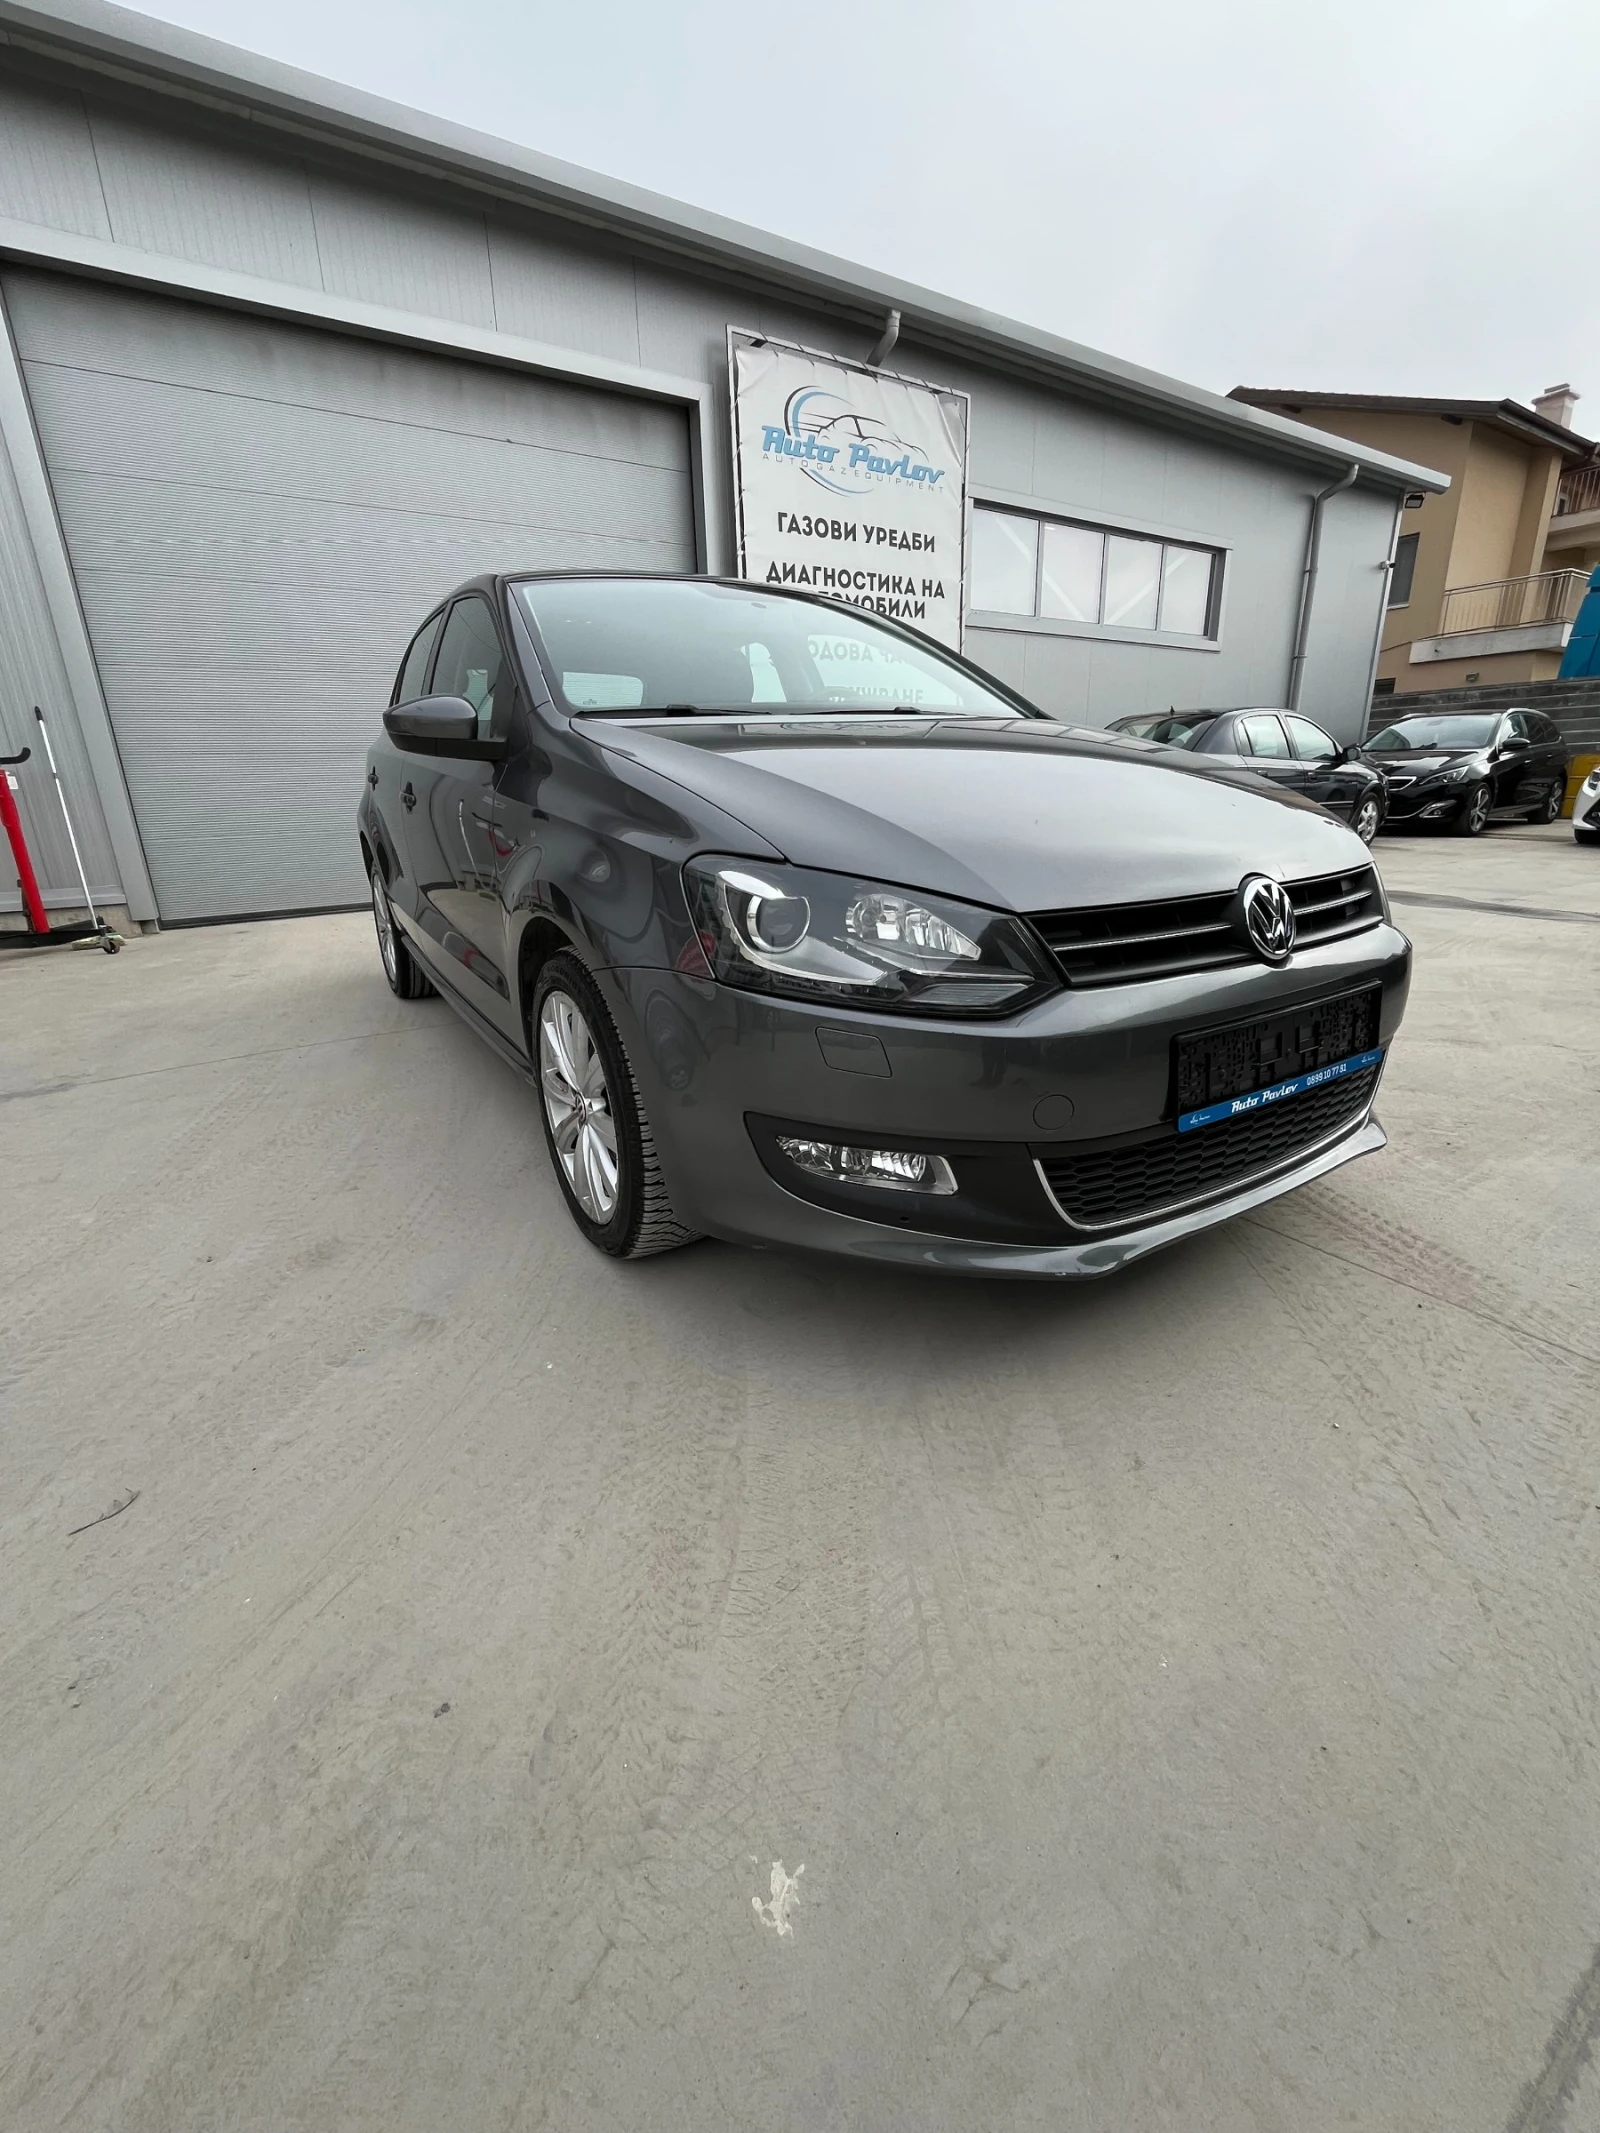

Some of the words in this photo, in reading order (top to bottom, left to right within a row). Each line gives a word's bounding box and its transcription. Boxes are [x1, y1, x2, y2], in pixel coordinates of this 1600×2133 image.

[761, 425, 840, 463] Auto
[848, 442, 945, 484] Pavlov
[778, 511, 857, 542] ГАЗОВИ
[863, 524, 935, 553] УРЕДБИ
[766, 561, 916, 596] ДИАГНОСТИКА
[922, 579, 945, 599] НА
[1231, 1097, 1259, 1113] Auto
[1262, 1083, 1298, 1103] Pavlov
